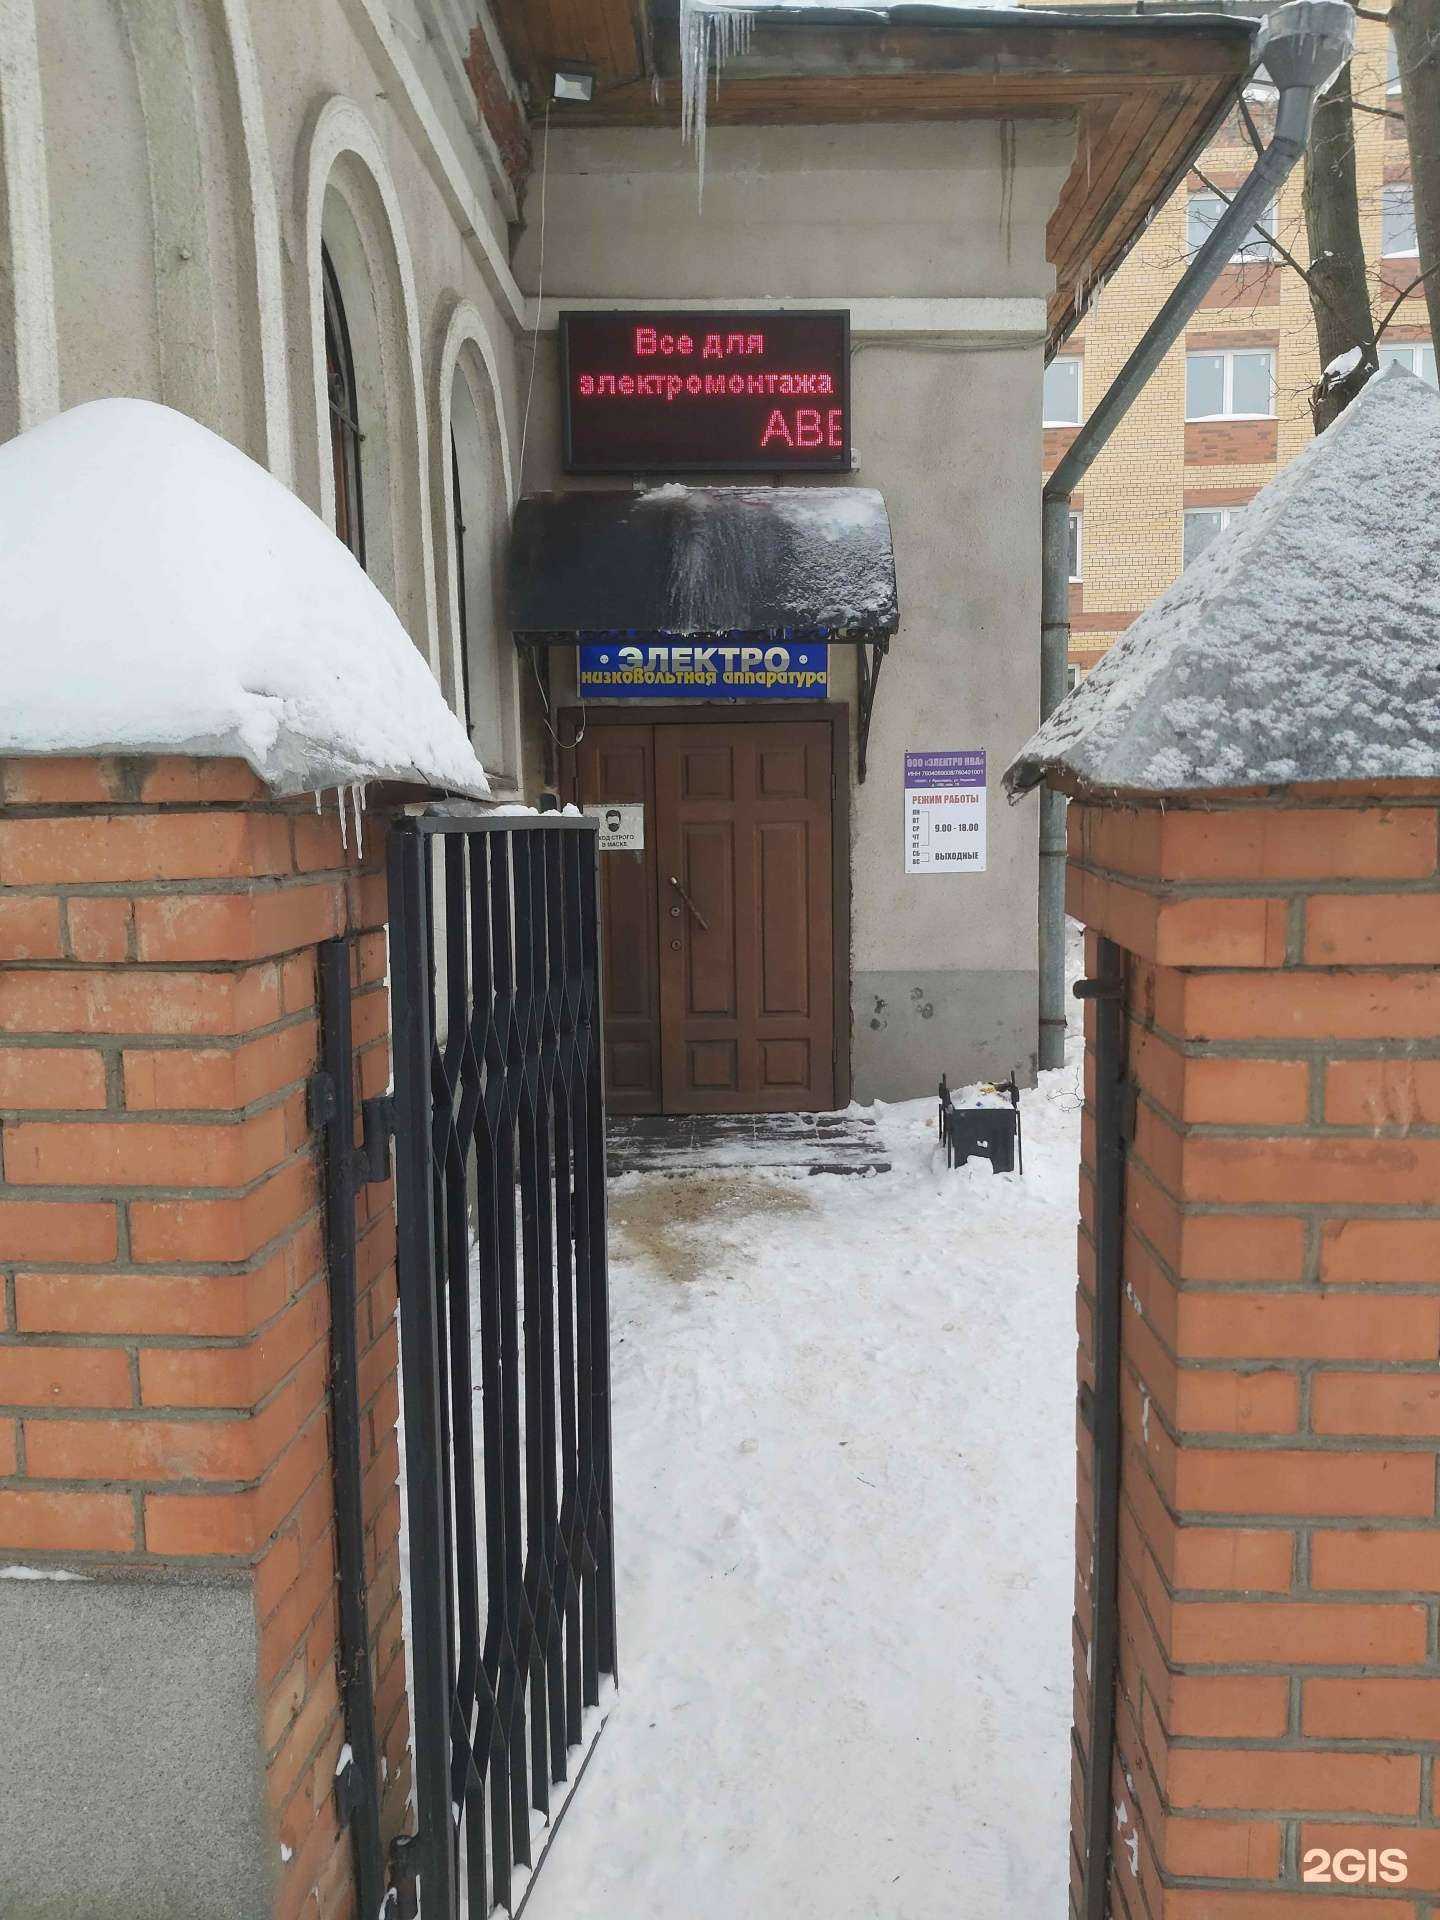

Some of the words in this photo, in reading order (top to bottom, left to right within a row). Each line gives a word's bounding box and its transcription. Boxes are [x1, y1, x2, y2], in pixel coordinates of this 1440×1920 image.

[636, 327, 693, 355] Все
[702, 334, 764, 358] для
[580, 373, 834, 400] электромонтажа
[618, 646, 791, 673] ЭЛЕКТРО
[581, 668, 717, 687] низковольтная
[722, 671, 828, 688] аппаратура
[912, 795, 942, 805] РЕЖИМ
[943, 794, 979, 804] РАБОТЫ
[934, 824, 952, 833] 9.00
[958, 823, 979, 832] 18.00
[935, 852, 979, 861] ВЫХОДНЫЕ
